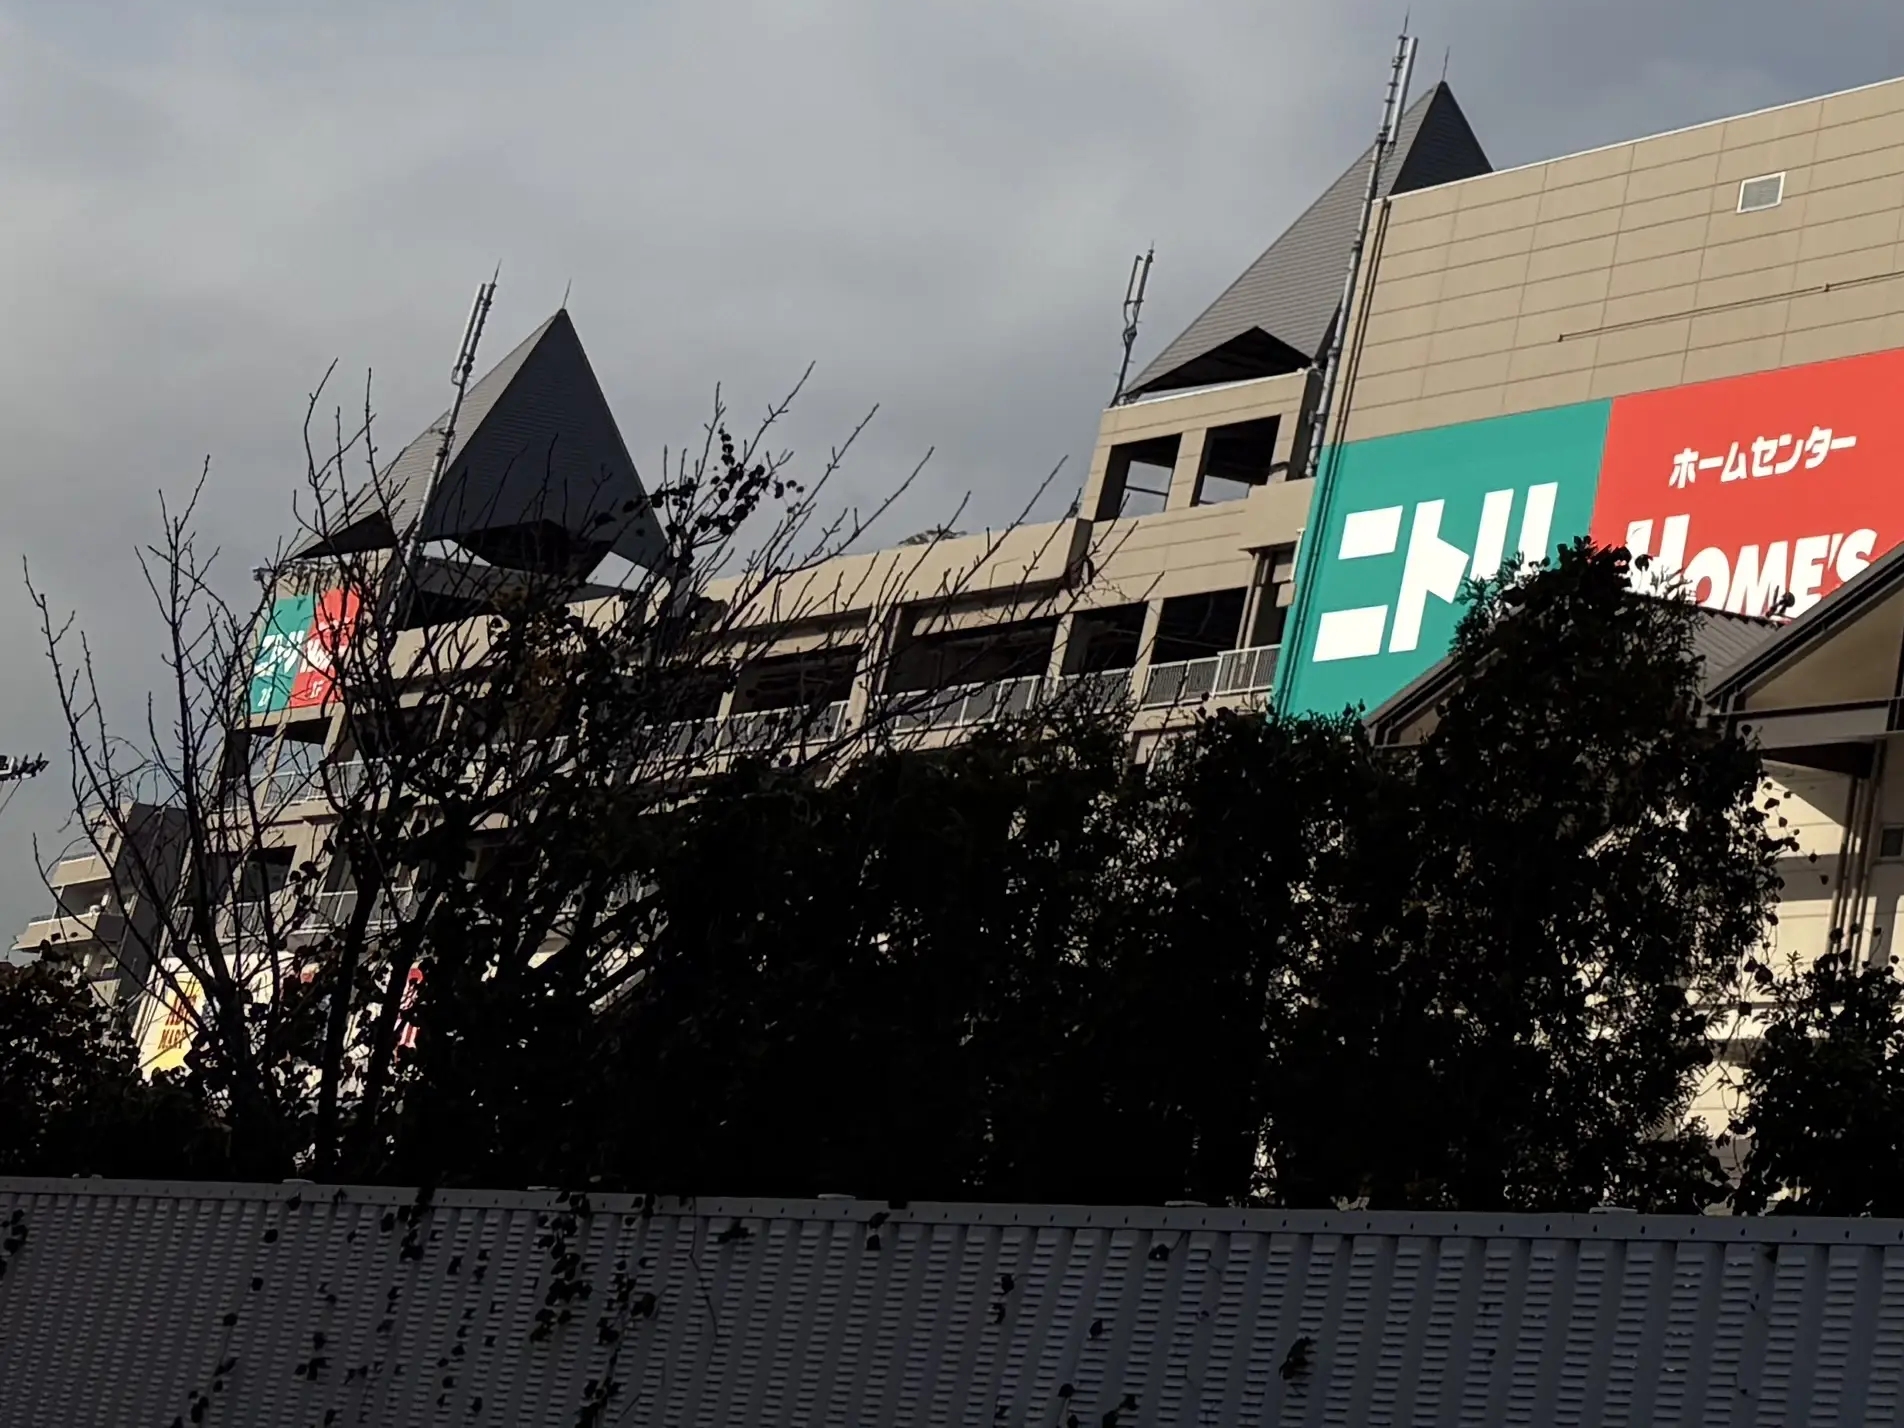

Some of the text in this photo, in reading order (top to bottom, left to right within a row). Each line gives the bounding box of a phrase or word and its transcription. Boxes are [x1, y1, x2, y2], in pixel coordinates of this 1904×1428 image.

[1668, 426, 1857, 489] ホームセンター
[1312, 482, 1558, 662] ニトリ
[1624, 513, 1878, 620] HOME'S
